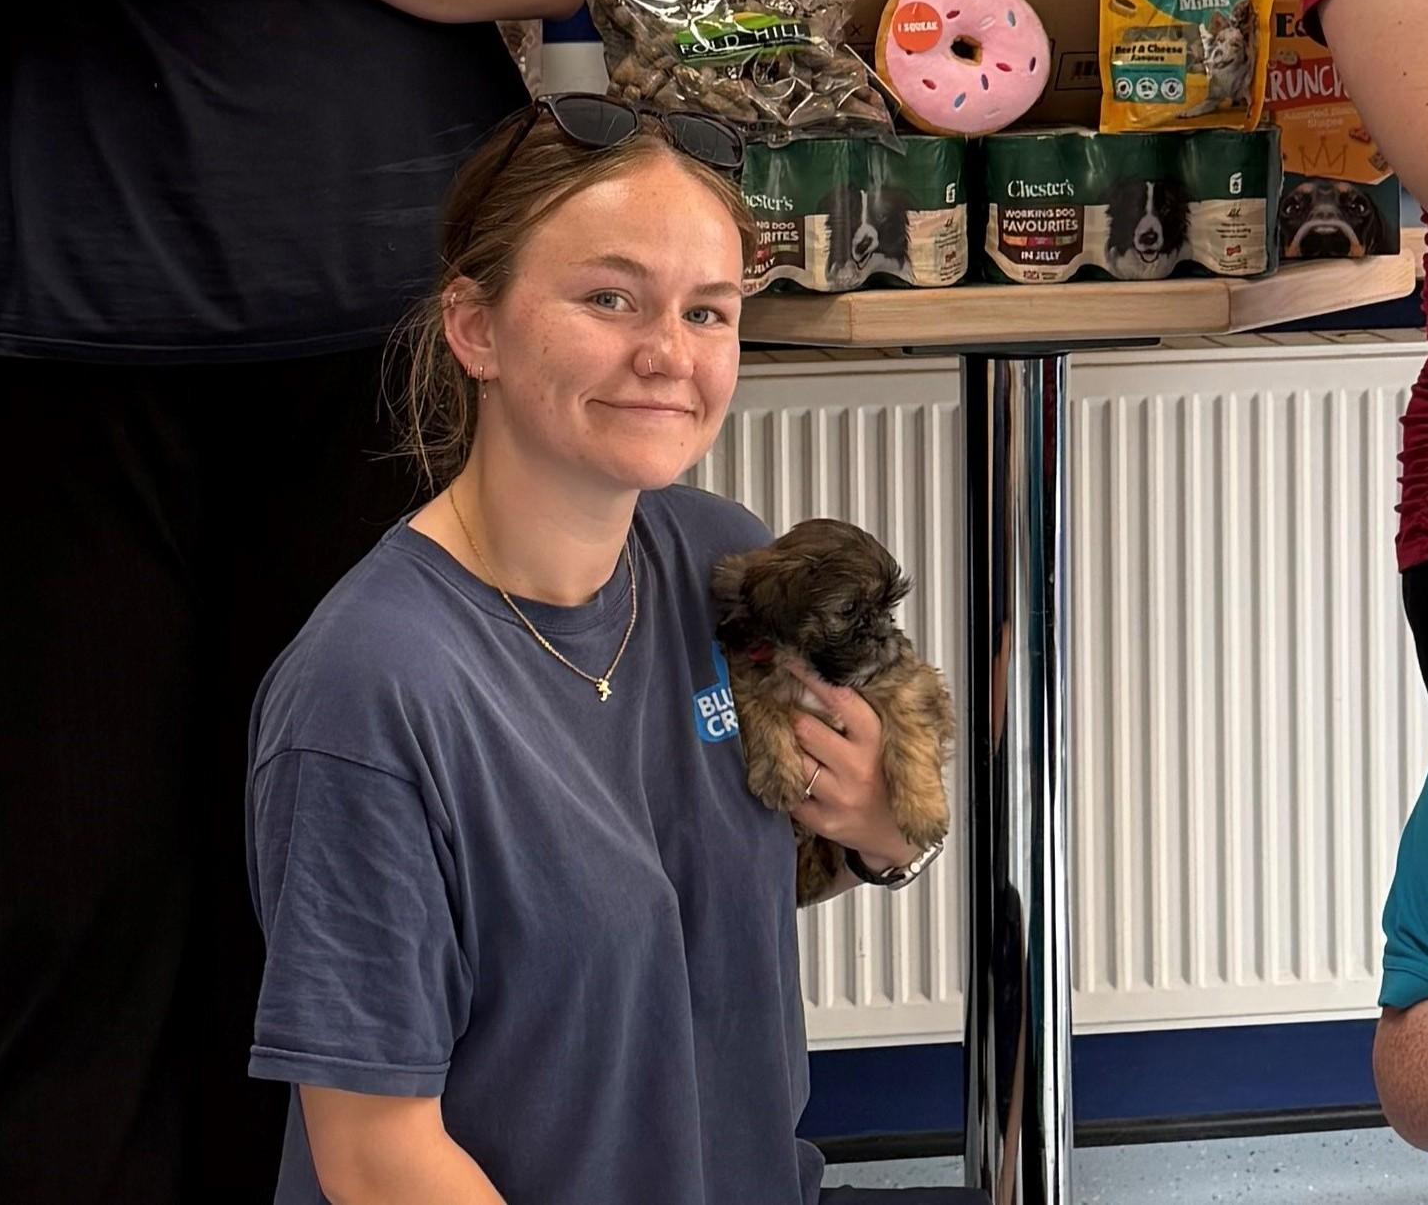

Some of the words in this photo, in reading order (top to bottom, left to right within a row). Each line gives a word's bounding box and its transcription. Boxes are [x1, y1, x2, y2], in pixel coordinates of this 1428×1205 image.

[903, 21, 938, 33] SQUEAK
[680, 34, 739, 54] FOLD
[755, 24, 805, 42] HILL
[1147, 43, 1183, 54] Cheese
[1007, 179, 1074, 198] Chester's
[741, 191, 794, 211] hester's
[1005, 209, 1054, 219] WORKING
[1055, 208, 1076, 217] DOG
[772, 222, 795, 230] DOG
[1003, 219, 1079, 232] FAVOURITES
[1021, 251, 1033, 260] IN
[1035, 250, 1061, 261] JELLY
[697, 688, 734, 718] BLU
[706, 710, 739, 736] CR
